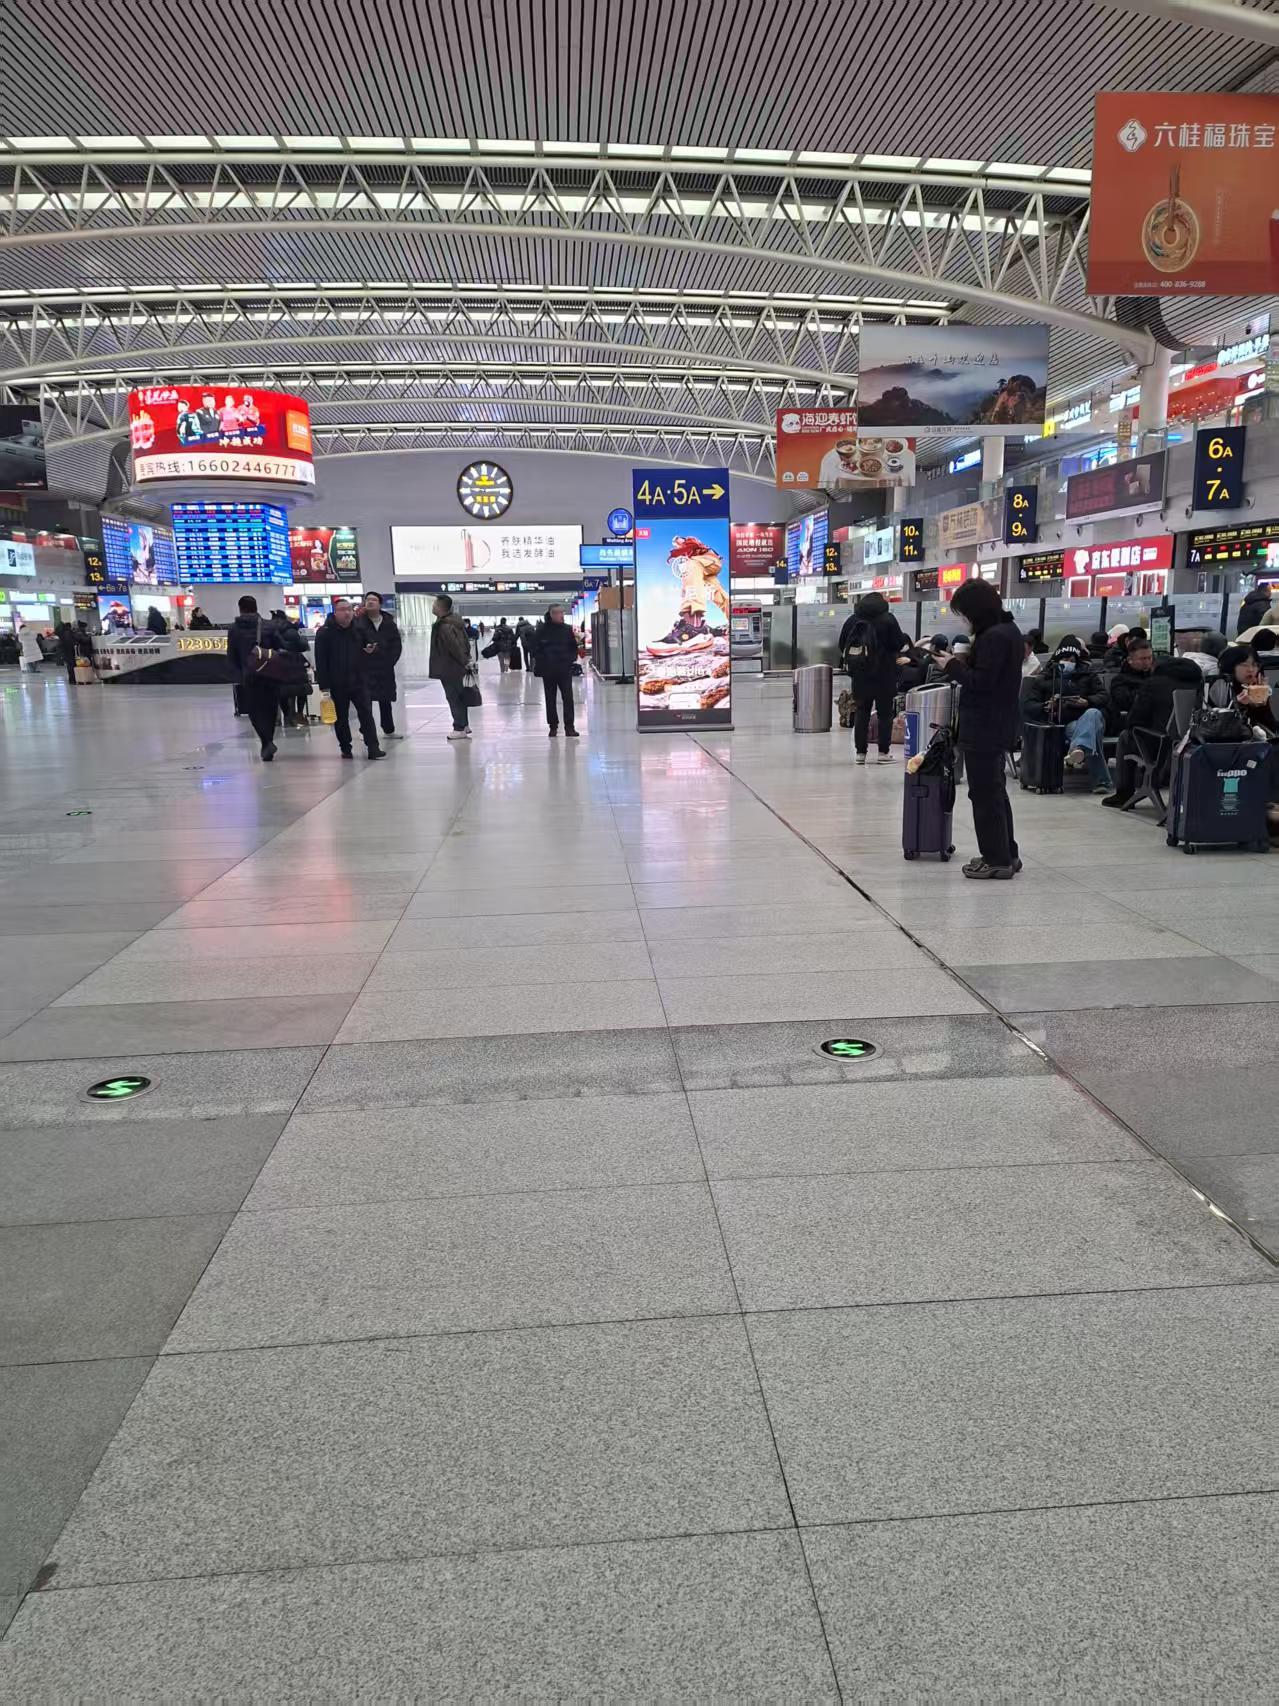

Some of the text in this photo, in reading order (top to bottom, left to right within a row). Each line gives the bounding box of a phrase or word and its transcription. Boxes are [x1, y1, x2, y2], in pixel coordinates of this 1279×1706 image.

[1153, 122, 1276, 148] 六桂福珠宝
[1207, 437, 1233, 459] 6A
[1206, 480, 1230, 501] 7A
[1013, 493, 1029, 508] 8A
[903, 525, 919, 537] 10A
[1011, 522, 1028, 536] 9A
[903, 544, 919, 556] 11A
[1190, 549, 1201, 563] 7A
